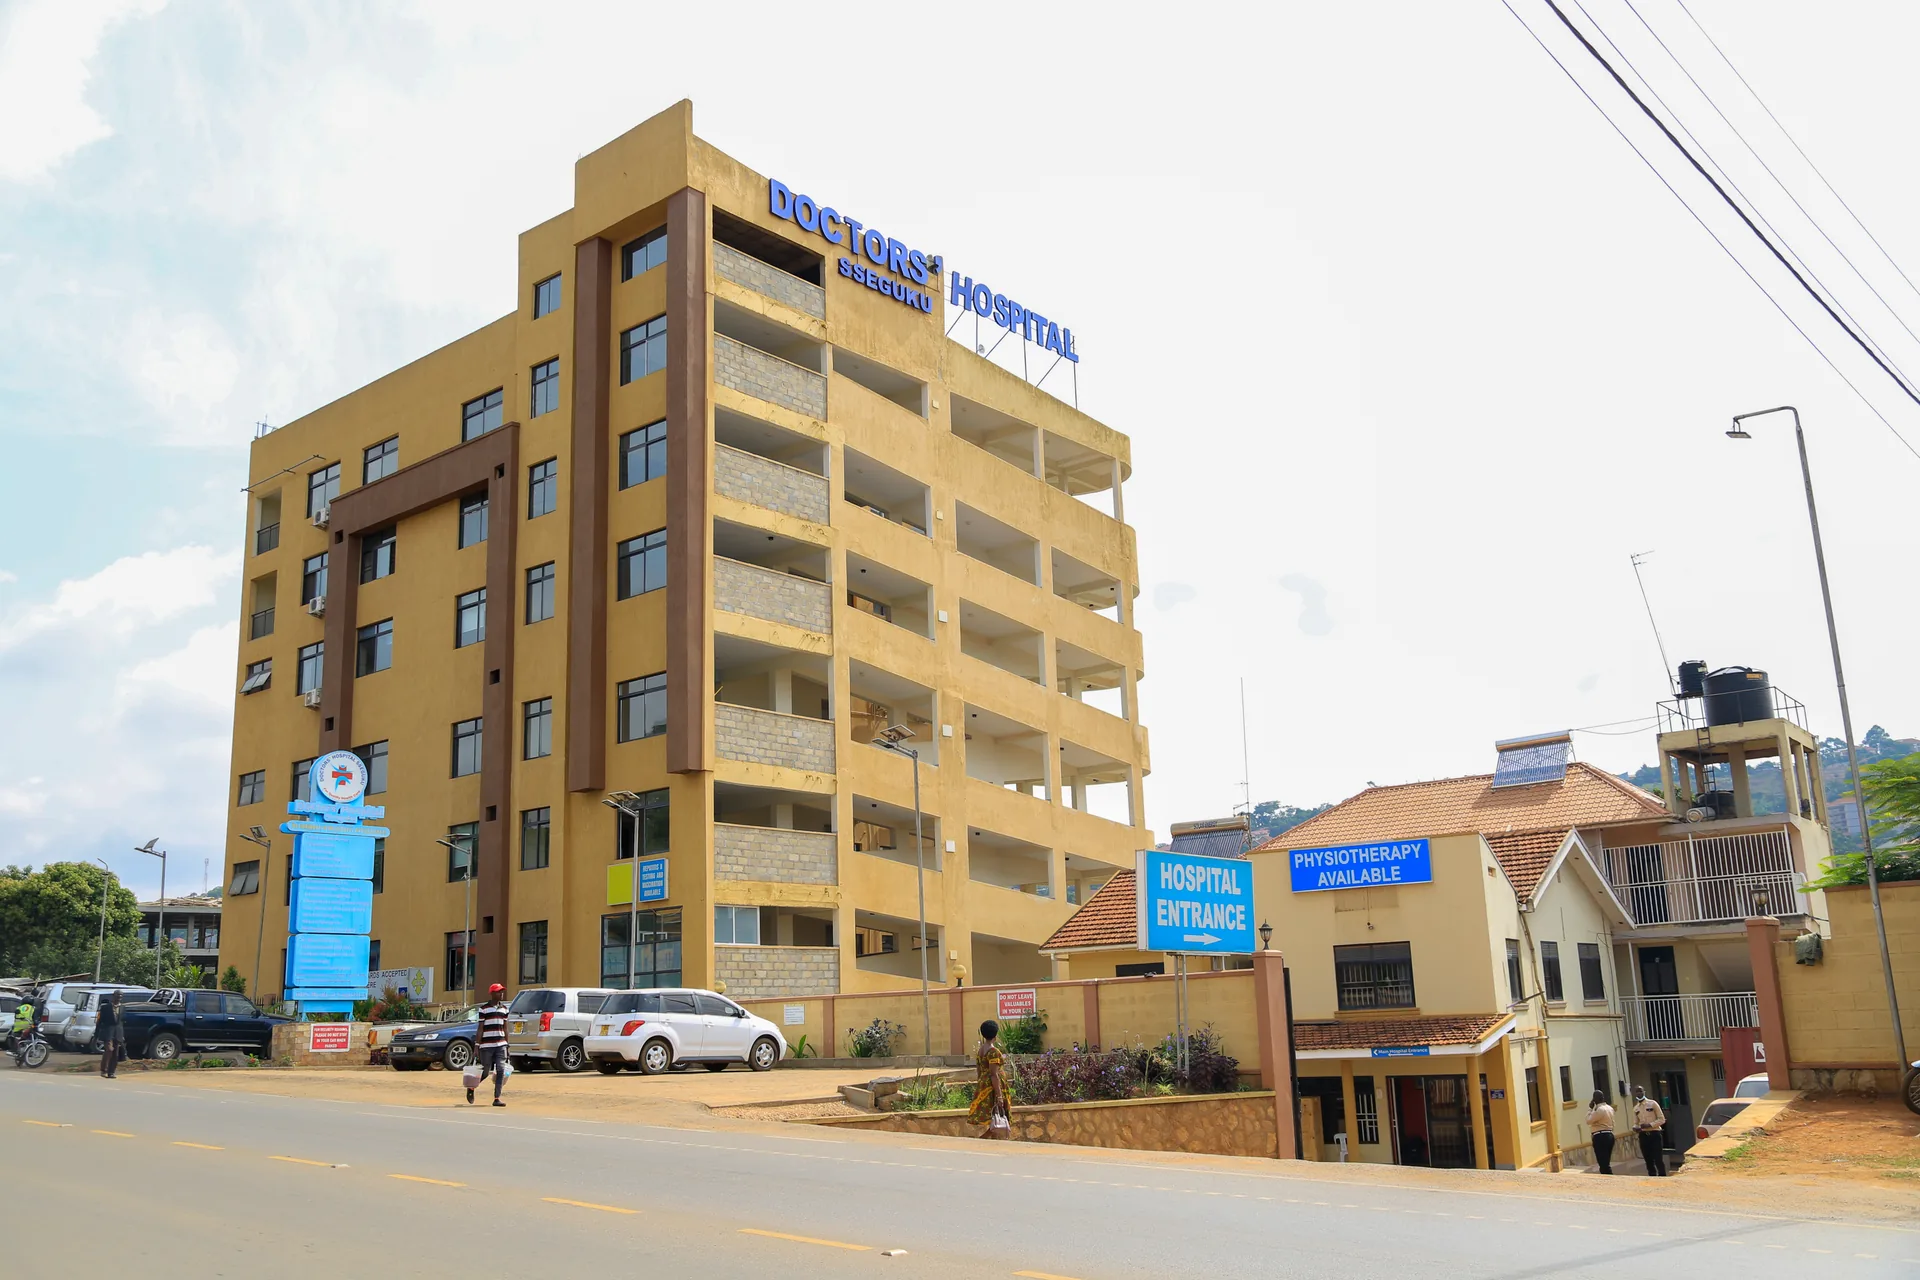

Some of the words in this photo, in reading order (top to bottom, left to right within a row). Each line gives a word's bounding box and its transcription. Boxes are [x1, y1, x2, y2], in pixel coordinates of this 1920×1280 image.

[838, 257, 933, 314] SSEGUKU
[951, 271, 1079, 363] HOSPITAL
[1294, 843, 1422, 869] PHYSIOTHERAPY
[1160, 862, 1242, 895] HOSPITAL
[1317, 866, 1401, 887] AVAILABLE
[1157, 898, 1247, 930] ENTRANCE
[382, 969, 408, 978] ACCEPTED
